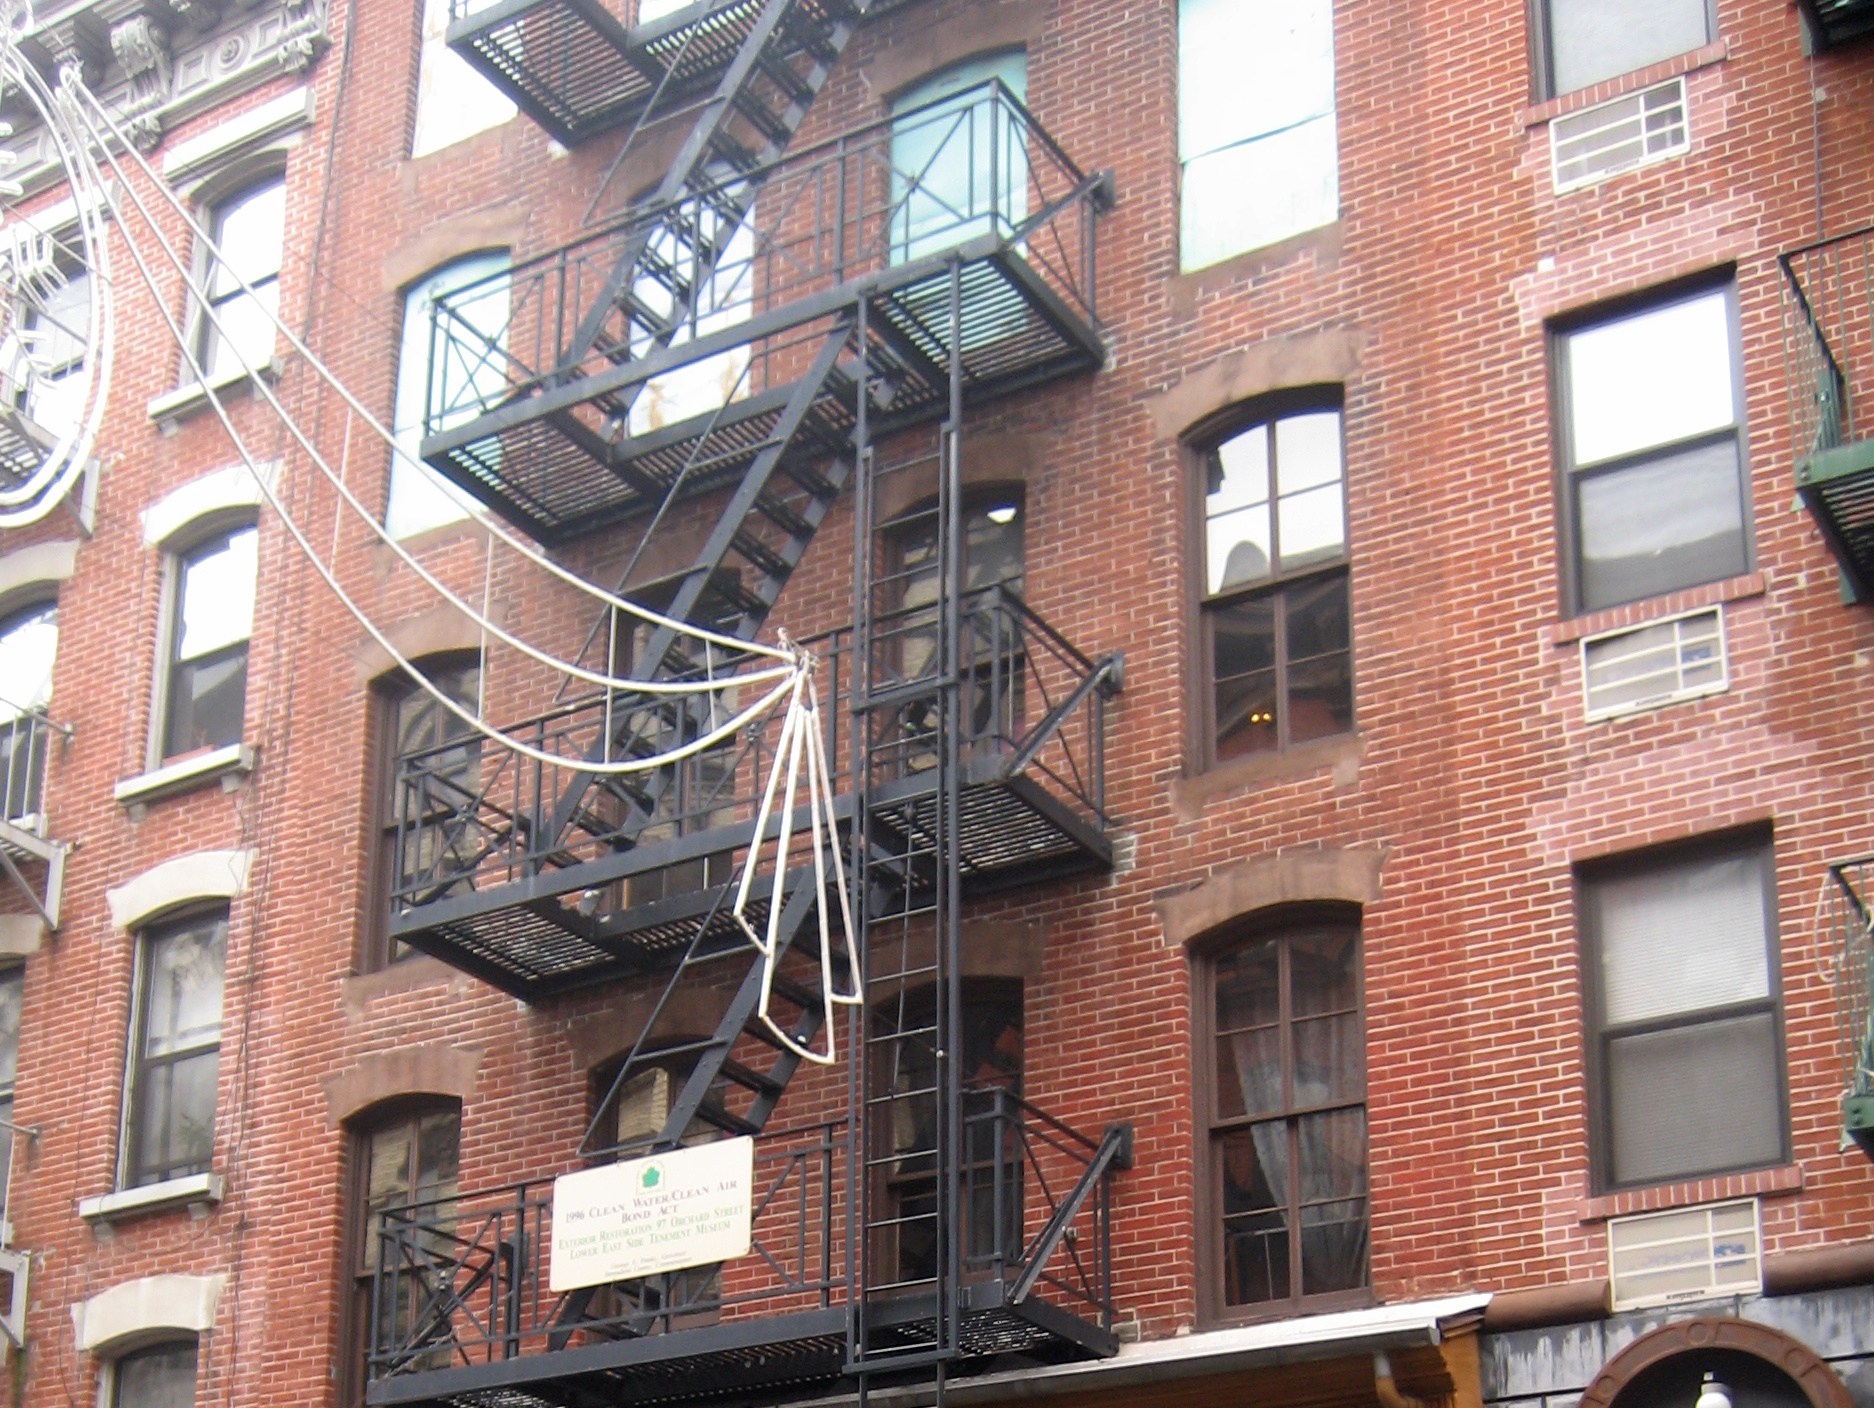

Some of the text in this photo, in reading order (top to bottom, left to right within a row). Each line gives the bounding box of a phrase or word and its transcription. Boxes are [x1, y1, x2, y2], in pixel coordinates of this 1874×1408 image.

[589, 1203, 624, 1218] CLEAN
[718, 1180, 737, 1191] AIR
[622, 1205, 679, 1224] BOND ACT
[570, 1246, 597, 1259] LOWER
[603, 1242, 621, 1253] EAST
[650, 1228, 690, 1243] TENEMENT
[696, 1220, 730, 1234] MUSEUM
[600, 1225, 651, 1241] RESTORATION
[656, 1219, 666, 1229] 97
[671, 1212, 709, 1226] ORCHARD
[714, 1205, 743, 1218] STREET
